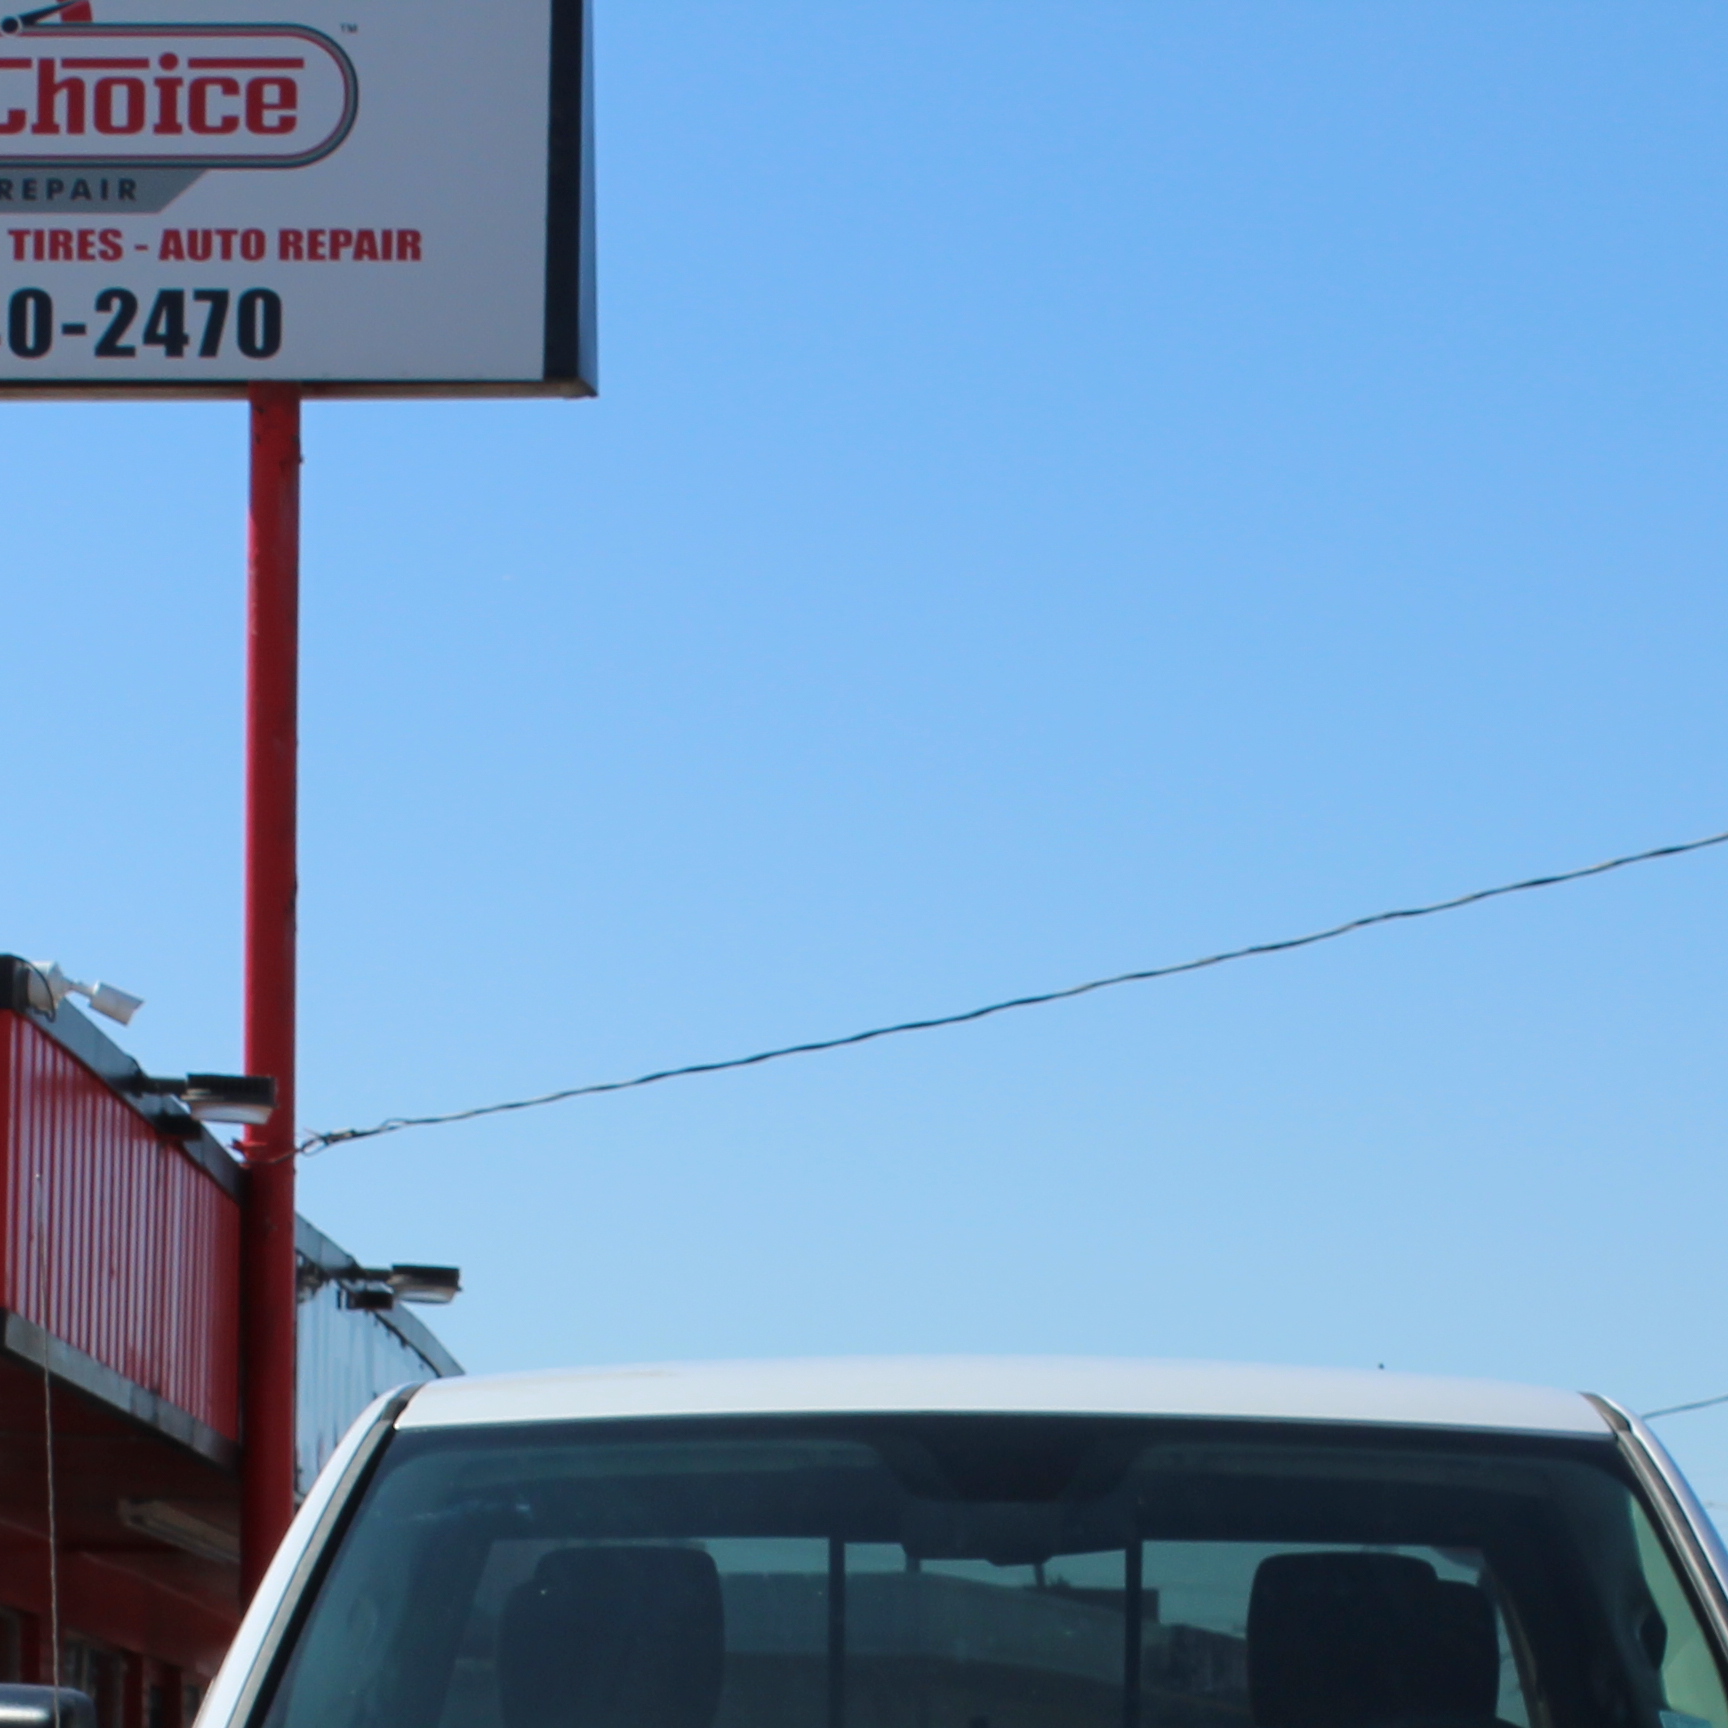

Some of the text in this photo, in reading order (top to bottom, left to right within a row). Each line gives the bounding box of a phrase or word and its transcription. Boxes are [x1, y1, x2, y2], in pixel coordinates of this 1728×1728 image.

[8, 228, 123, 262] TIRES
[158, 228, 266, 262] AUTO
[278, 228, 422, 262] REPAIR
